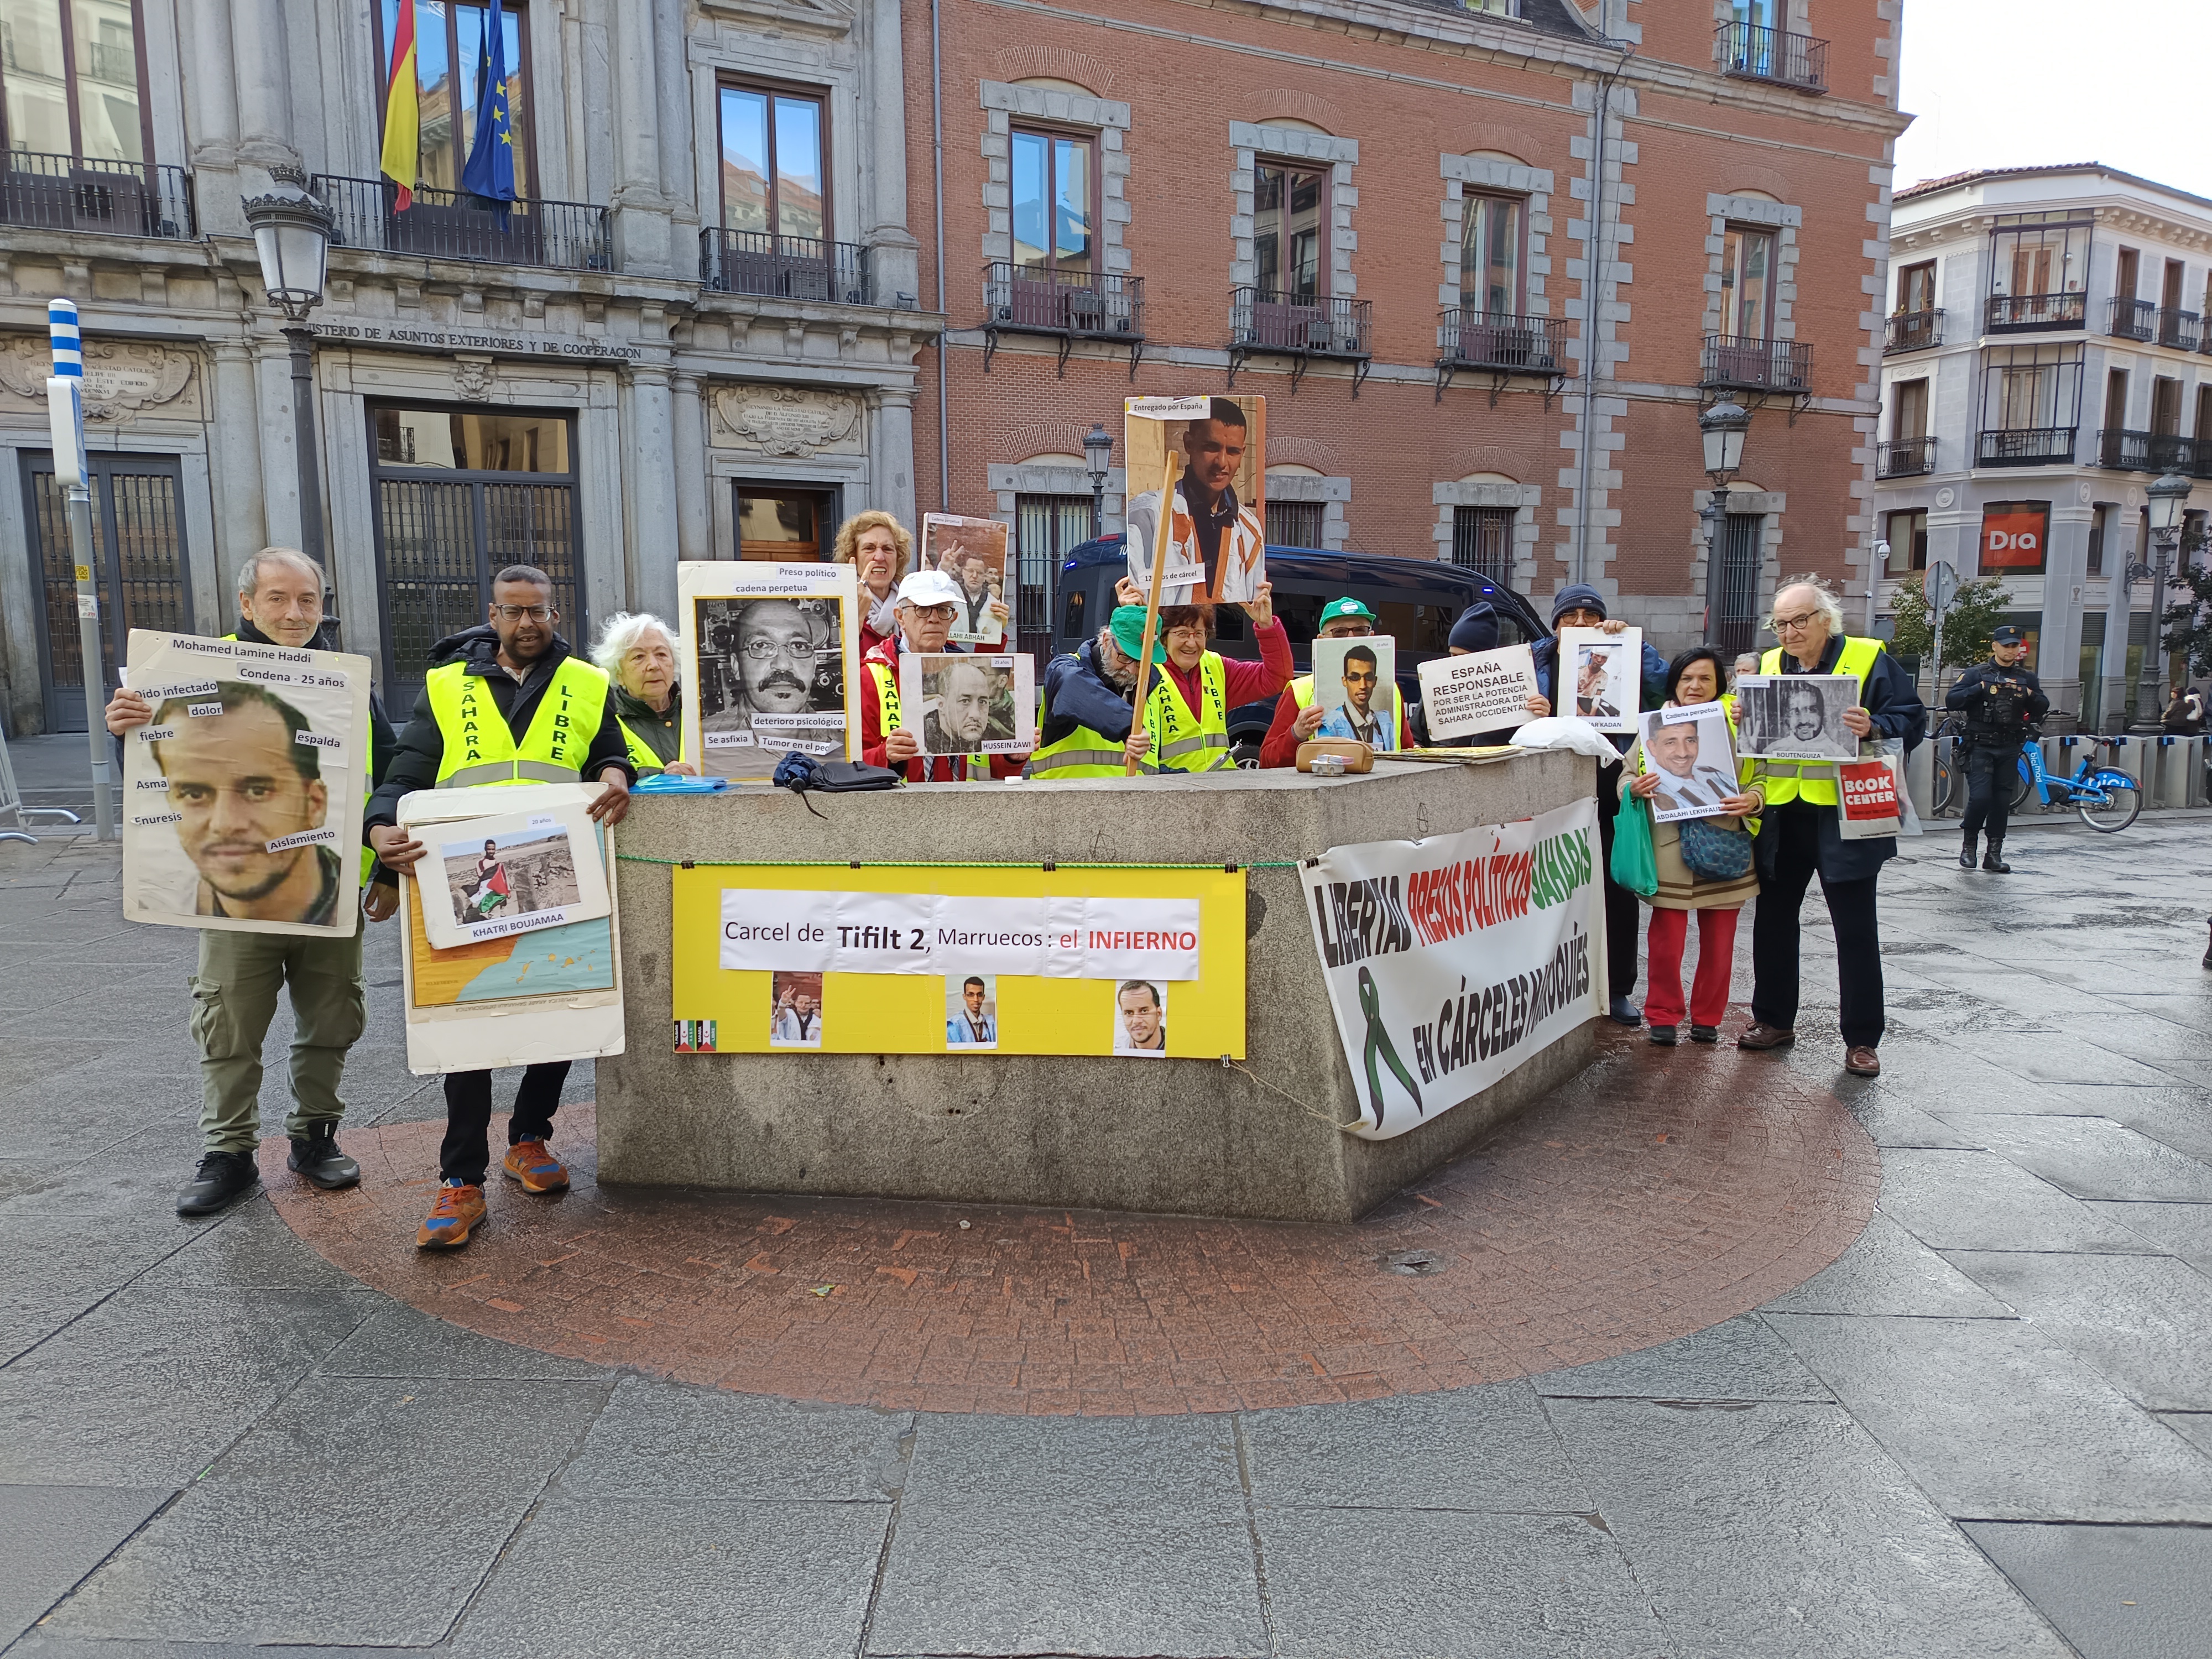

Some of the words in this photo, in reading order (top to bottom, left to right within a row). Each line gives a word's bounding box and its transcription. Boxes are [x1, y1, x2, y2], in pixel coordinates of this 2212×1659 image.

[364, 327, 382, 339] DE
[388, 329, 445, 344] ASUNTOS
[450, 333, 524, 350] EXTERIORES
[529, 341, 537, 352] Y
[543, 342, 559, 353] DE
[564, 343, 641, 359] COOPERACION
[1134, 404, 1166, 412] Entregado
[1180, 403, 1203, 411] España
[779, 568, 803, 576] Preso
[805, 567, 837, 578] político
[735, 584, 766, 592] cadena
[769, 584, 807, 593] perpetua
[173, 639, 231, 655] Mohamed
[234, 646, 275, 660] Lamine
[278, 651, 311, 664] Haddi
[240, 668, 290, 682] Condena
[301, 674, 315, 685] 25
[318, 675, 345, 688] años
[1451, 662, 1502, 680] ESPAÑA
[163, 681, 217, 696] infectado
[1433, 672, 1525, 697] RESPONSABLE
[1204, 666, 1223, 720] LIBRE
[1433, 698, 1451, 707] POR
[1453, 694, 1471, 703] SER
[1486, 685, 1528, 698] POTENCIA
[191, 705, 222, 716] dolor
[1436, 697, 1511, 716] ADMINISTRADORA
[1512, 693, 1528, 703] DEL
[1438, 713, 1474, 725] SAHARA
[1665, 711, 1688, 719] Cadena
[1690, 707, 1718, 717] perpetua
[461, 681, 482, 761] SAHARA
[551, 685, 573, 761] LIBRE
[754, 717, 795, 726] deterioro
[796, 717, 843, 727] psicológico
[139, 729, 174, 742] fiebre
[297, 733, 341, 748] espalda
[720, 734, 748, 743] asfixia
[762, 737, 791, 748] Tumor
[983, 742, 1012, 750] HUSSEIN
[136, 780, 167, 790] Asma
[1844, 775, 1893, 792] BOOK
[1845, 791, 1896, 805] CENTER
[134, 812, 182, 826] Enuresis
[1656, 810, 1688, 821] ABDALAHI
[270, 830, 335, 849] Aislamiento
[1313, 875, 1412, 968] LIBERTAD
[1407, 862, 1464, 947] PRESOS
[1463, 836, 1534, 932] POLÍTICOS
[472, 924, 508, 938] KHATRI
[510, 913, 564, 931] BOUJAMAA
[725, 921, 790, 941] Carcel
[798, 923, 824, 942] de
[837, 926, 901, 950] Tifilt
[910, 928, 931, 954] 2,
[939, 928, 1043, 947] Marruecos
[1060, 929, 1077, 948] el
[1088, 931, 1196, 951] INFIERNO
[1412, 1022, 1437, 1085] EN
[1437, 974, 1528, 1076] CÁRCELES
